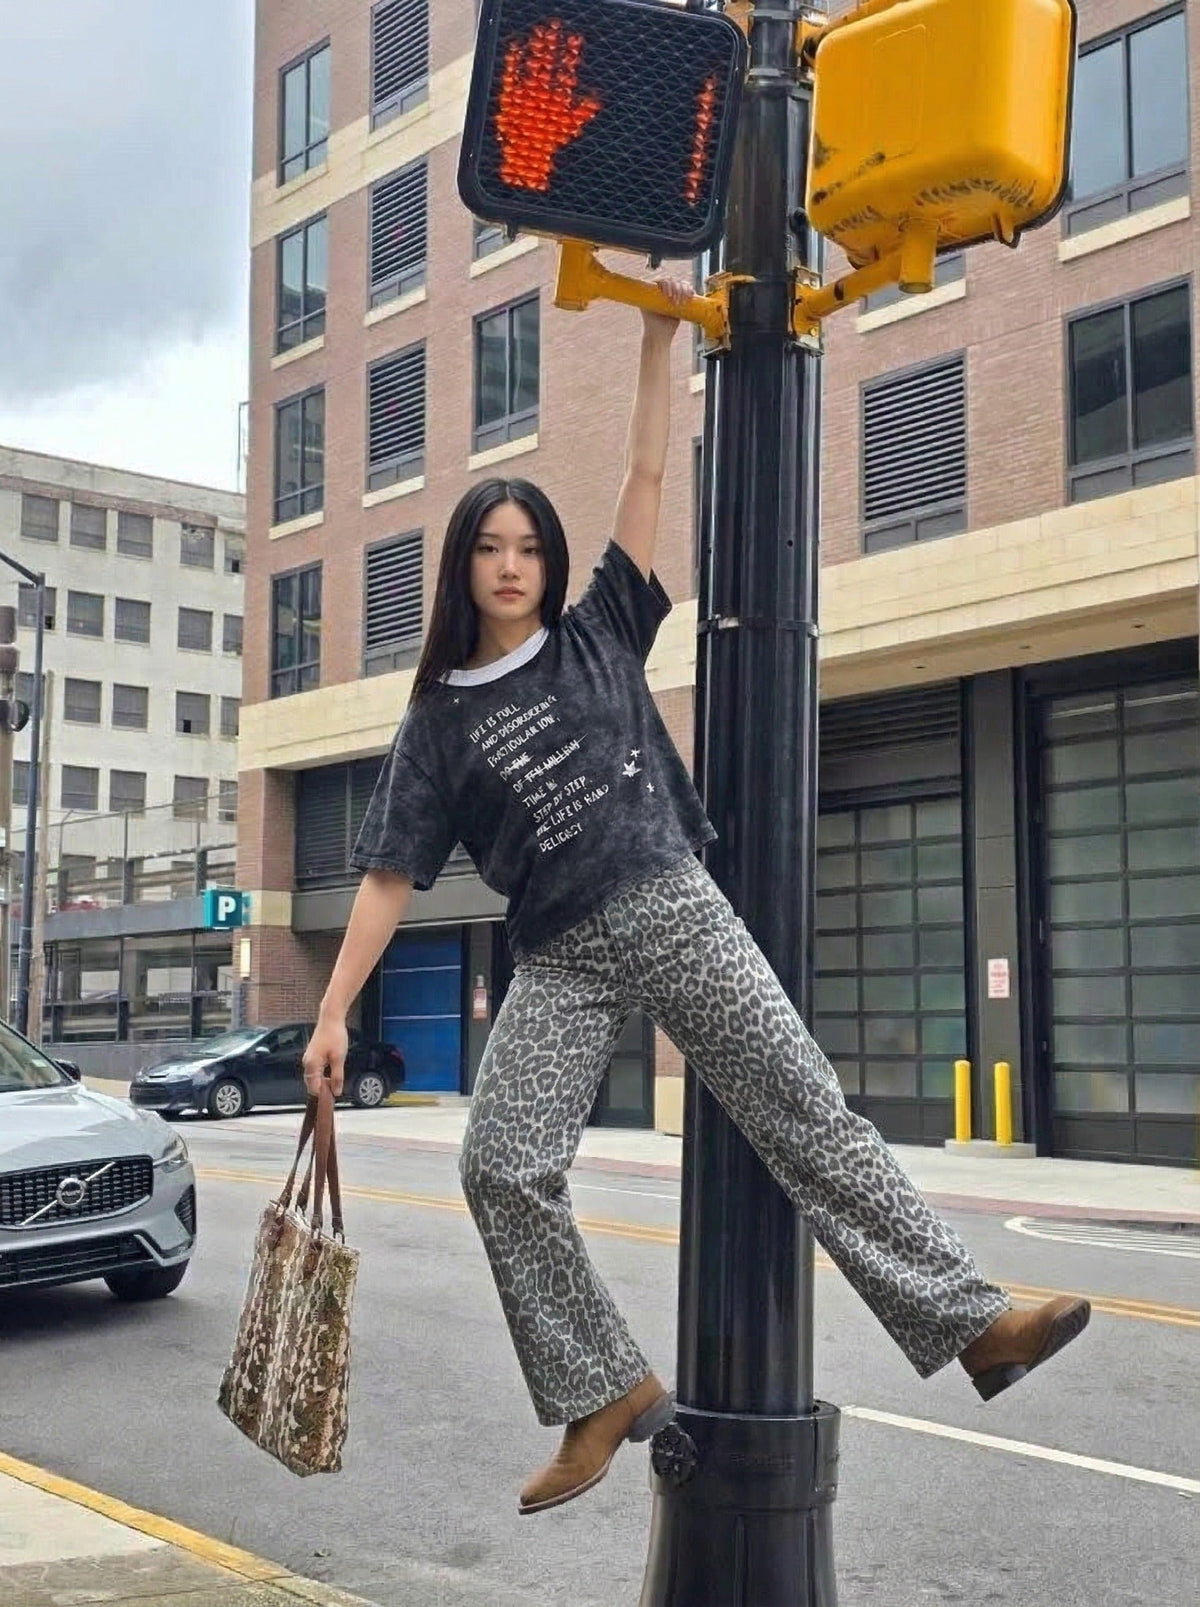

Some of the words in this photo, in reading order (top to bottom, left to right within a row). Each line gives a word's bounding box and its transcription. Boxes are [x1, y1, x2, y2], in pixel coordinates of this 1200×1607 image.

[486, 716, 497, 728] IS
[496, 704, 521, 721] FULL
[481, 734, 498, 752] AND
[572, 800, 583, 812] IS
[218, 895, 237, 922] P
